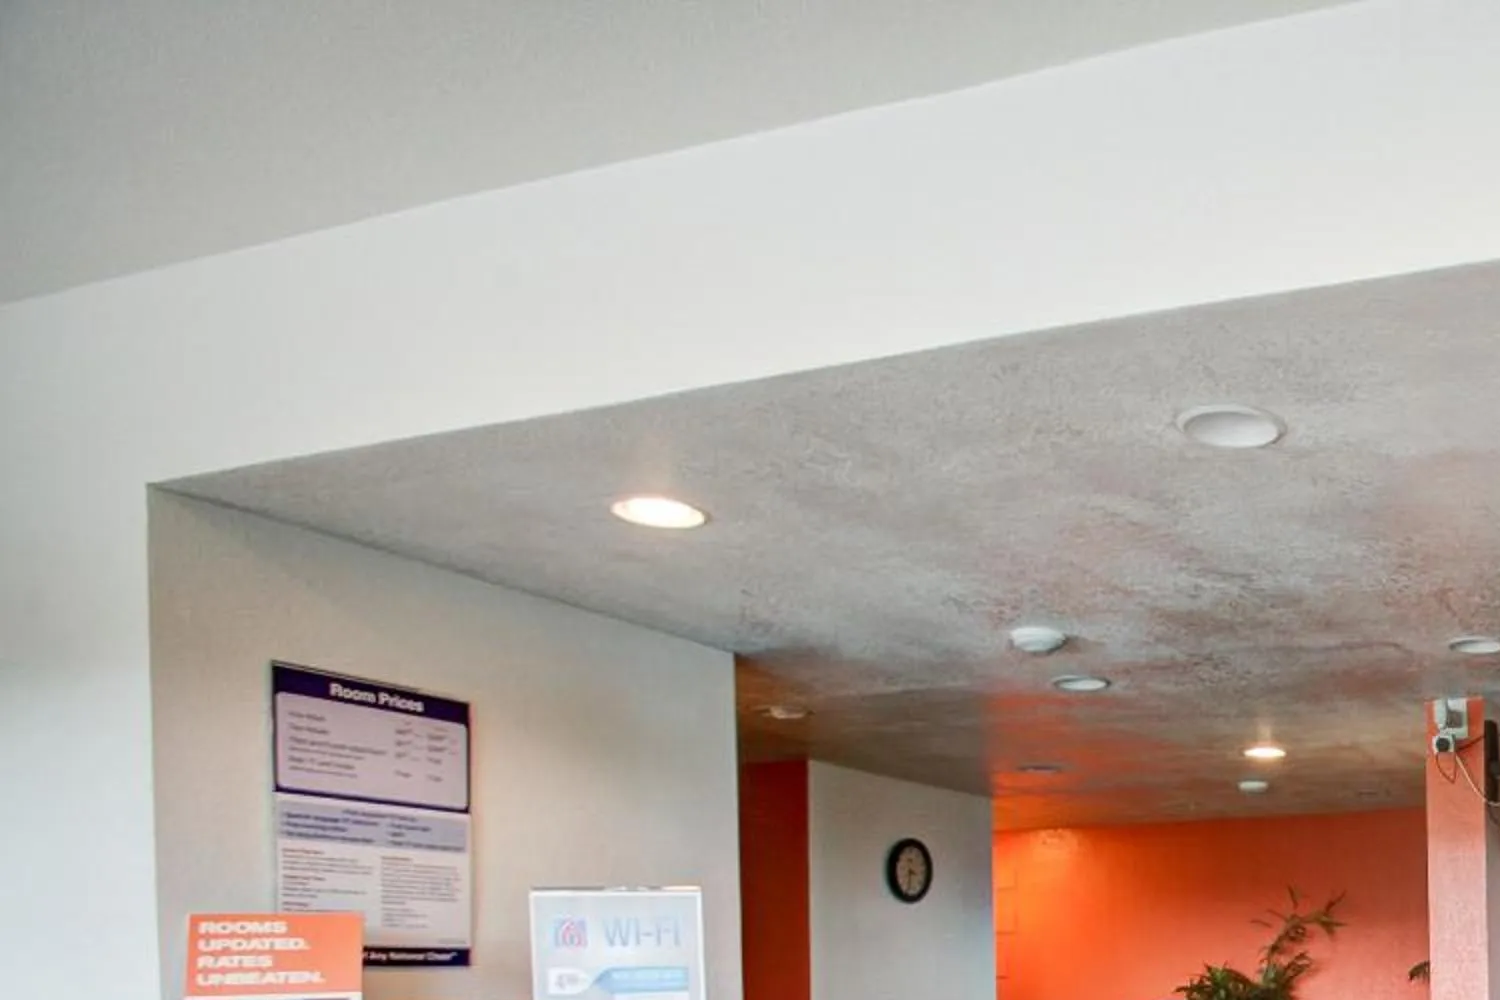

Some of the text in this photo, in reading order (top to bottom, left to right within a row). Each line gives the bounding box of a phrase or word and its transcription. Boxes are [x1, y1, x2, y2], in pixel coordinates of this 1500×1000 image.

[329, 683, 425, 713] Room Prices
[198, 920, 288, 935] ROOMS
[602, 915, 681, 948] WI-FI
[197, 937, 311, 951] UPDATED.
[196, 954, 273, 969] RATES
